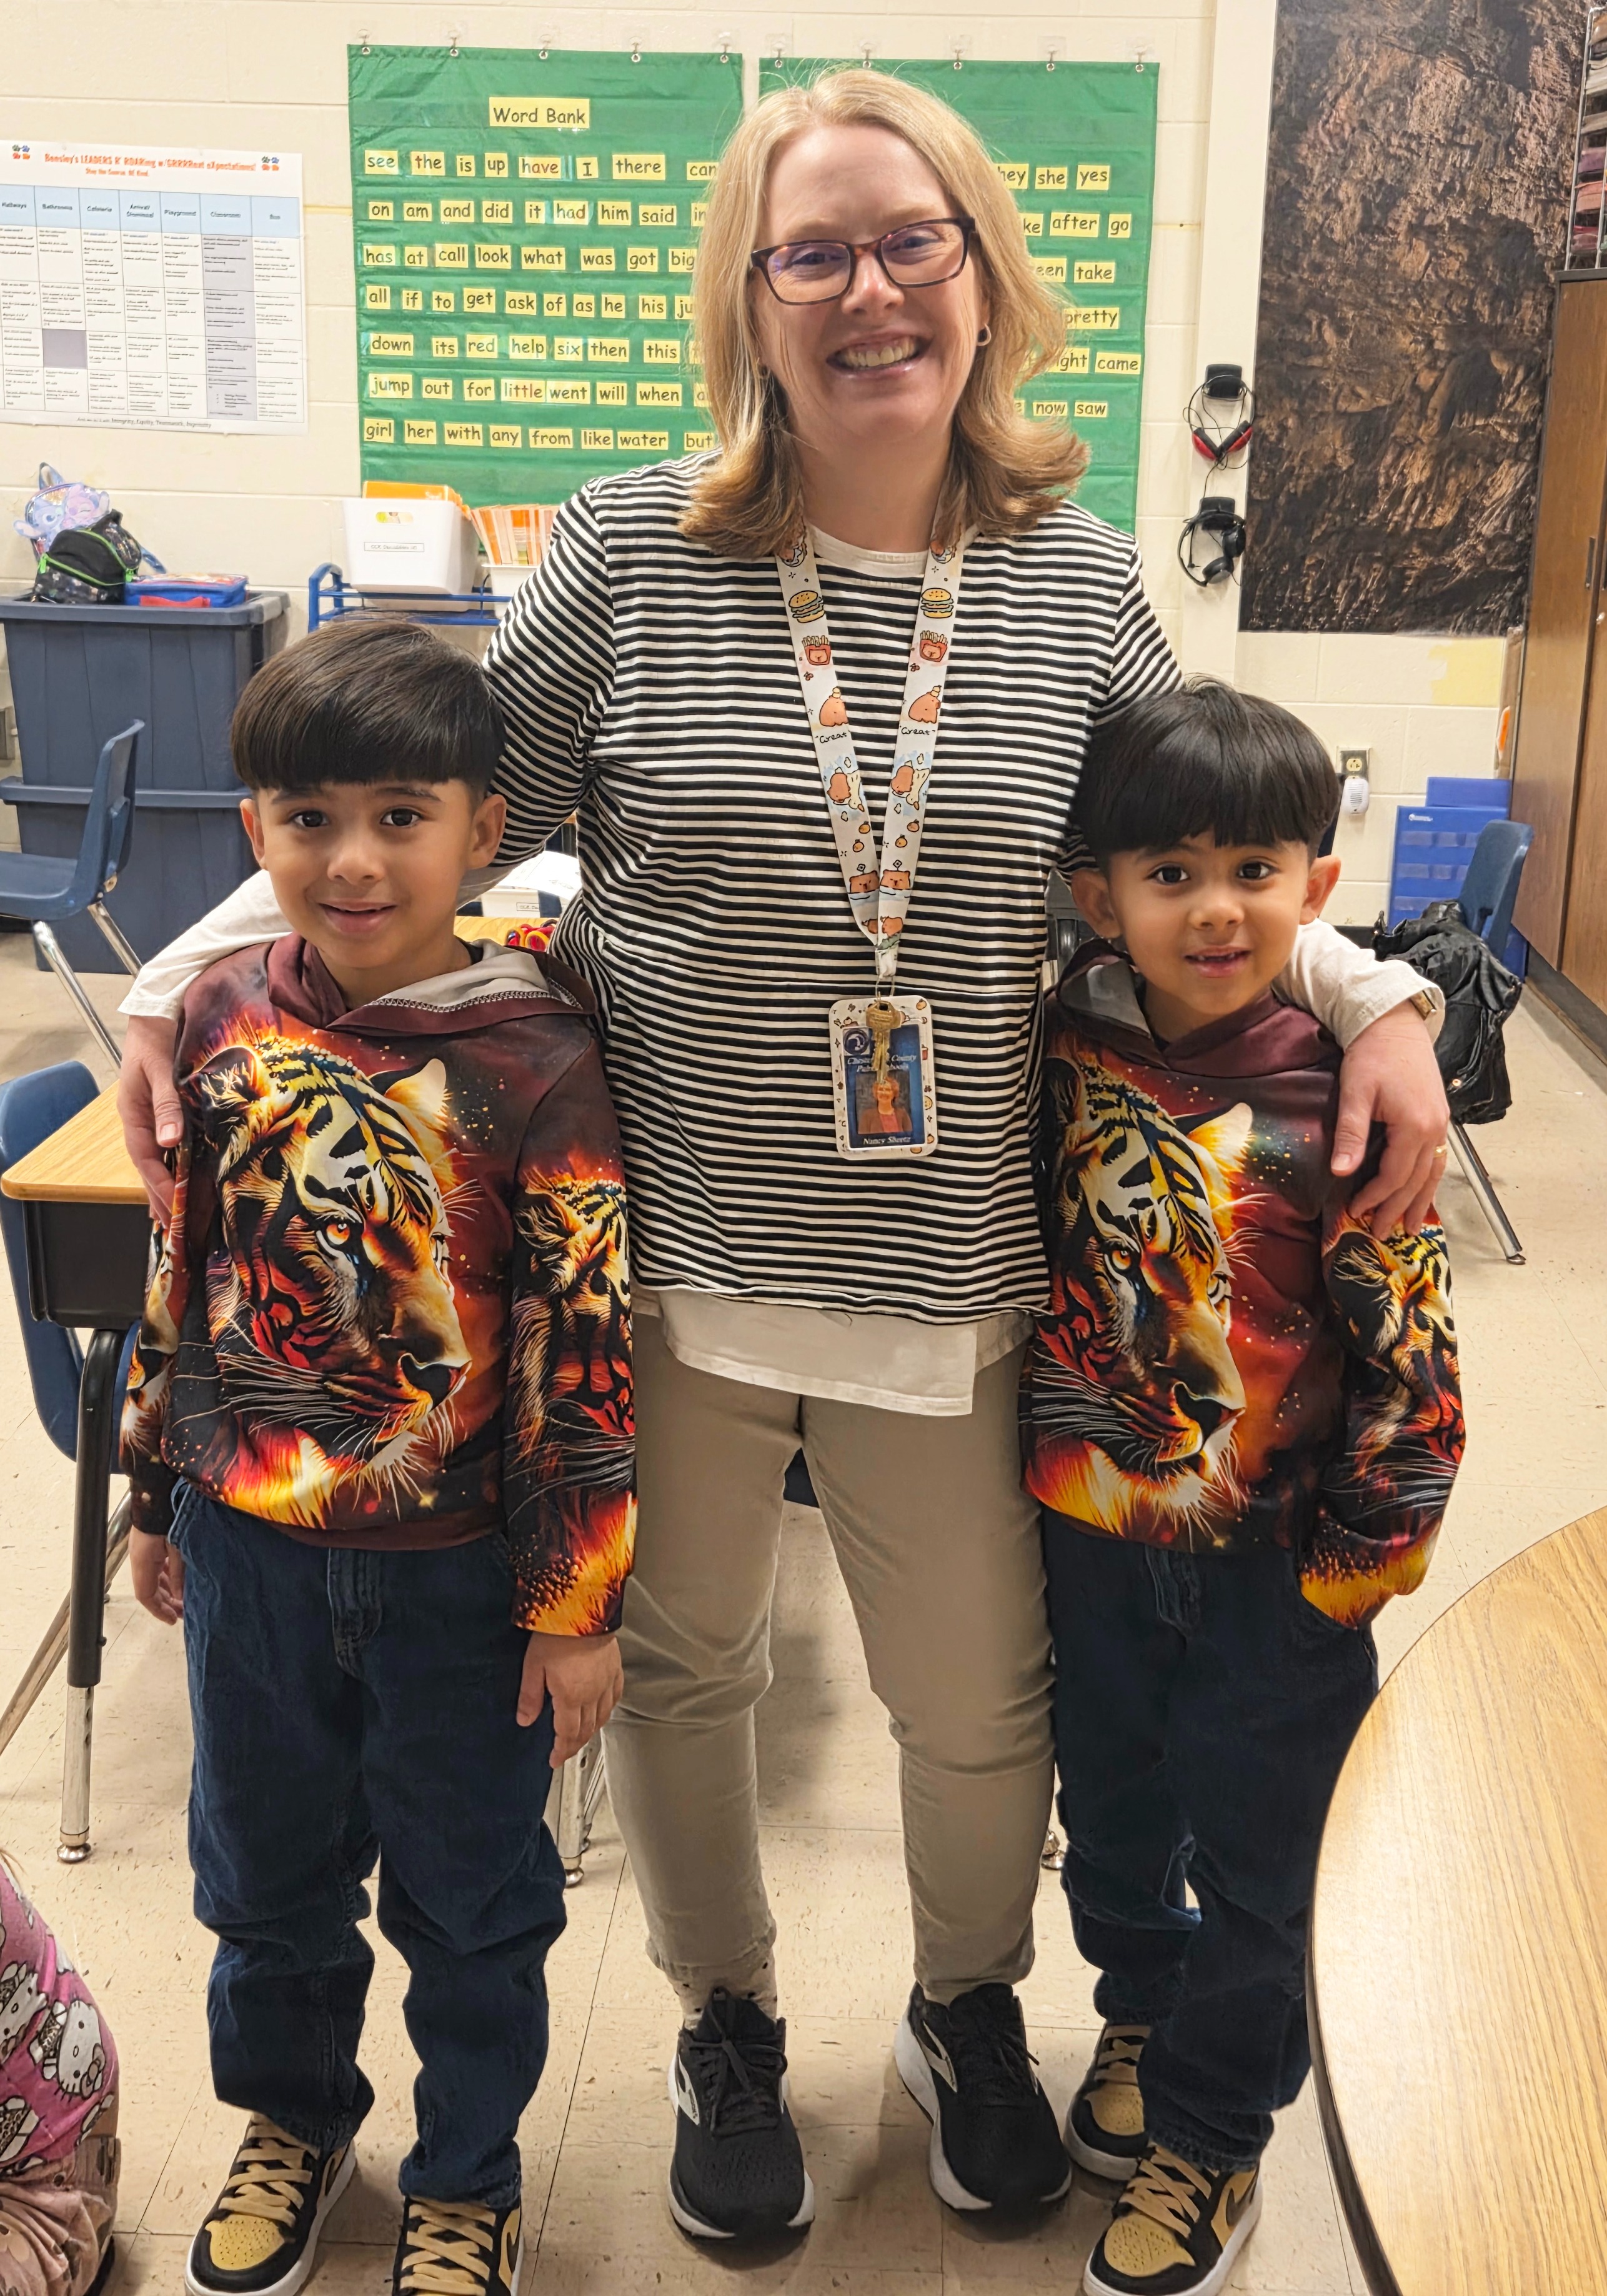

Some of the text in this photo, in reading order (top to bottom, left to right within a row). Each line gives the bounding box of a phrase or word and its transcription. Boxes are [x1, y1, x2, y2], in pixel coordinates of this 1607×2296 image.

[493, 107, 585, 124] Word Bank
[367, 154, 717, 177] see the is up have I there can
[1038, 169, 1065, 185] she
[1079, 170, 1108, 187] yes
[371, 205, 389, 216] on
[406, 207, 429, 218] am
[443, 202, 470, 217] and
[485, 202, 509, 218] did
[529, 204, 542, 219] it
[557, 203, 586, 220] had
[601, 204, 629, 221] him
[642, 207, 674, 223] said
[1023, 214, 1130, 236] ke after go
[366, 246, 695, 271] has at call look what was got big
[1035, 264, 1113, 281] een take
[369, 289, 694, 319] all if to get ask of as he his ju
[371, 336, 677, 359] down its red help six then this
[1097, 358, 1139, 371] came
[371, 377, 410, 397] jump
[424, 382, 450, 395] out
[467, 382, 492, 397] for
[504, 383, 542, 399] little
[550, 386, 587, 400] went
[599, 386, 624, 401] will
[639, 386, 679, 402] when
[1035, 402, 1065, 415] now
[1077, 404, 1106, 415] saw
[365, 423, 712, 448] girl her with any from like water but
